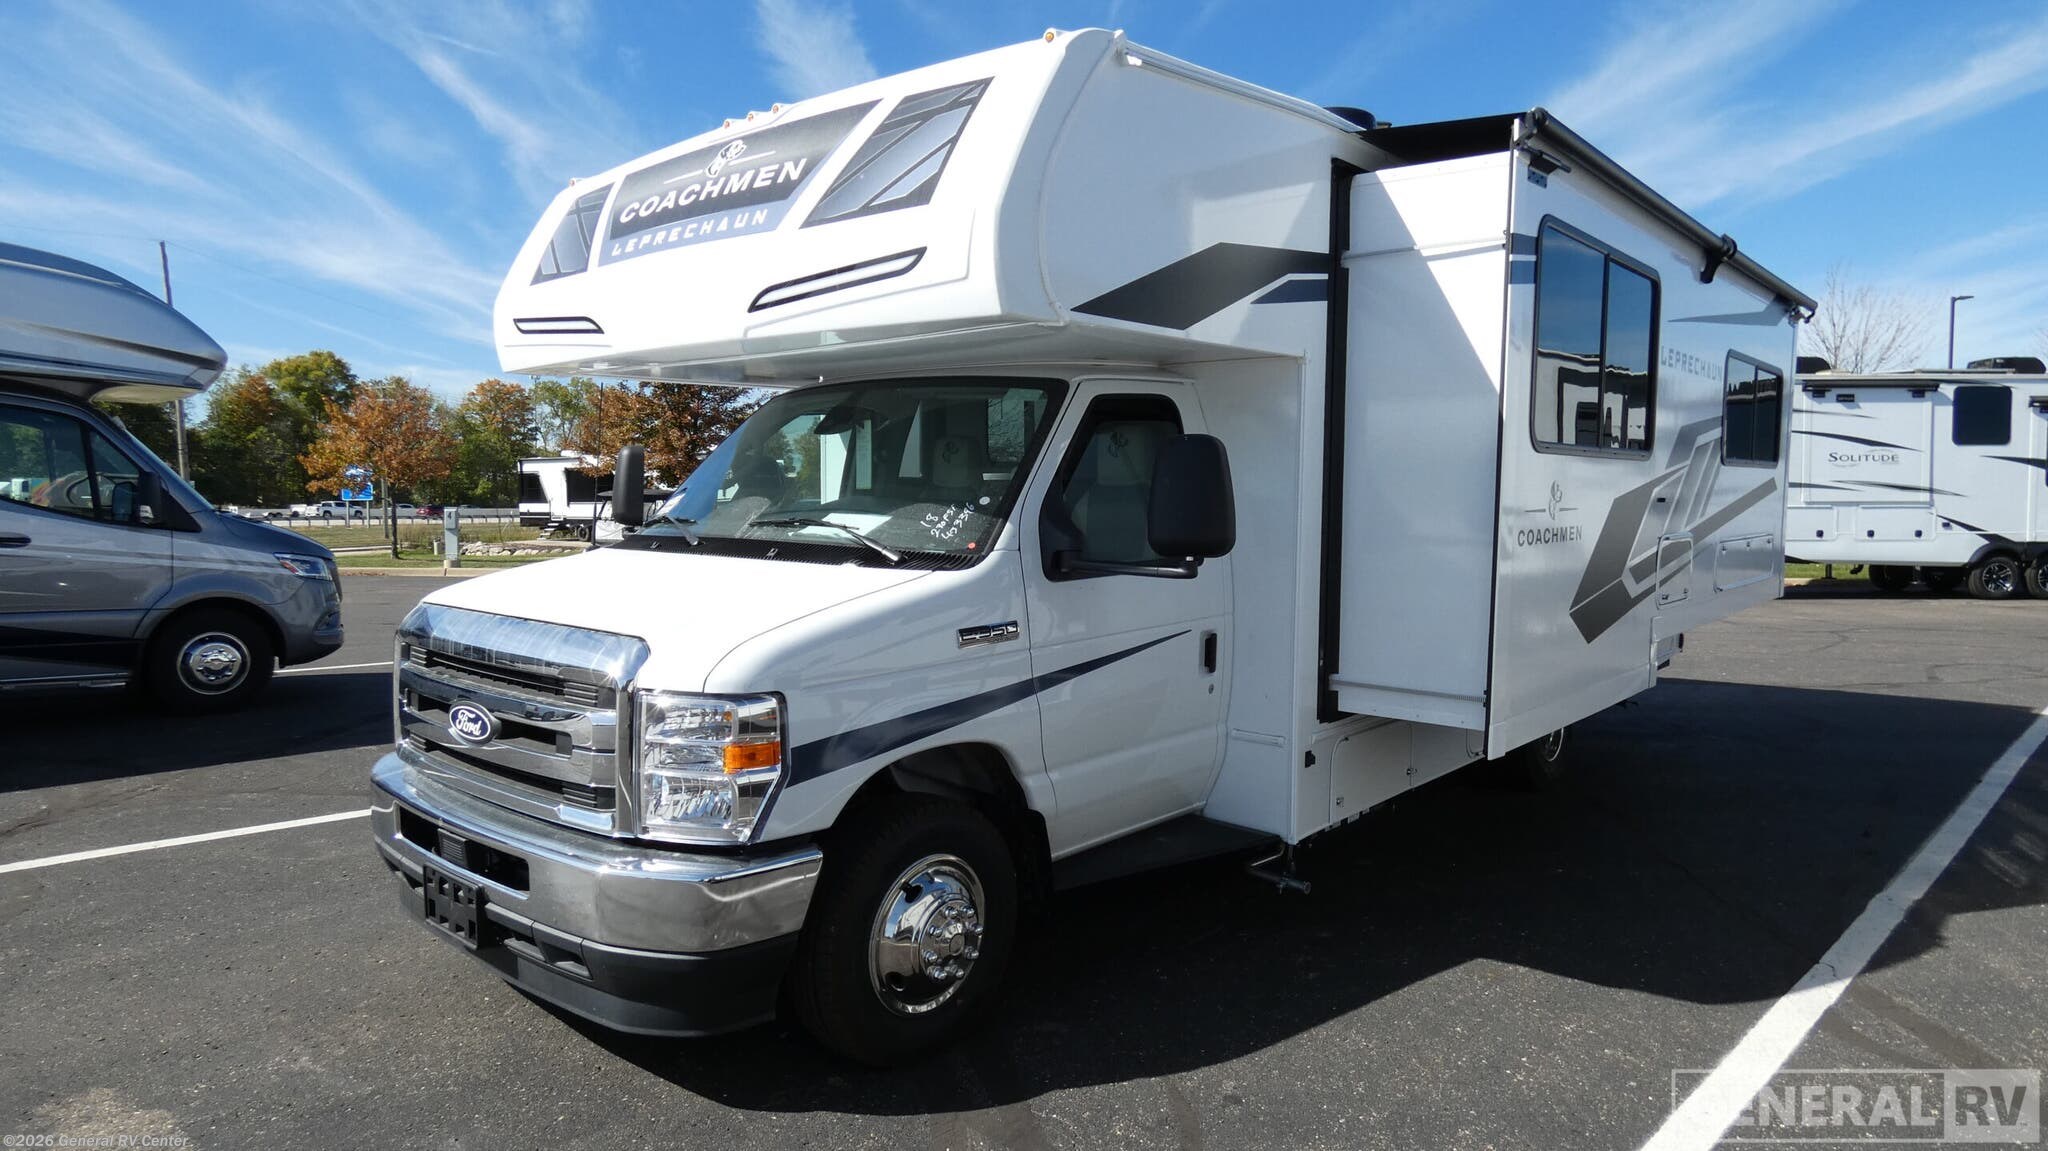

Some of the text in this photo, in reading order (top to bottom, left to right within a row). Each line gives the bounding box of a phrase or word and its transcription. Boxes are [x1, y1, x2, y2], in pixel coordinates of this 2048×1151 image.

[619, 157, 808, 225] COACHMEN
[611, 208, 768, 257] LEPRECHAUN
[1828, 451, 1900, 463] SOLITUDE
[1517, 525, 1583, 547] COACHMEN
[455, 709, 482, 736] Ford
